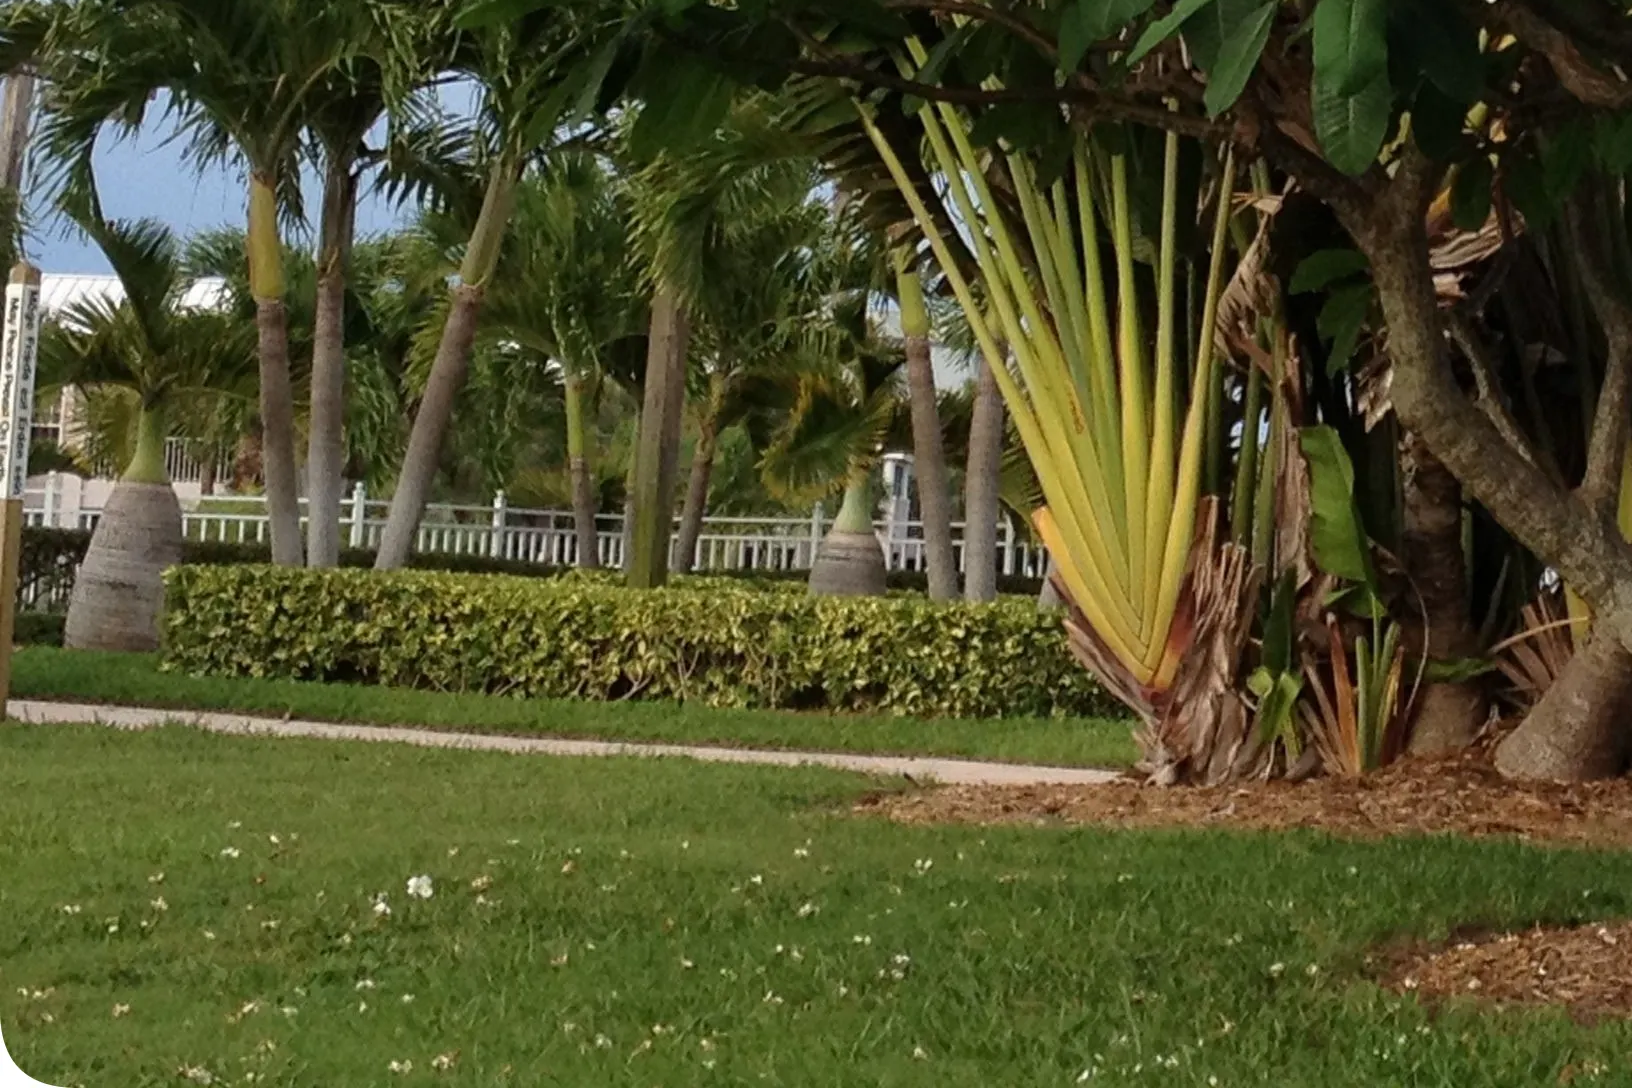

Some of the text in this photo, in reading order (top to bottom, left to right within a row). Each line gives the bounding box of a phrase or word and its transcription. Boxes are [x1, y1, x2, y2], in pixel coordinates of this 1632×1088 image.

[8, 297, 19, 325] May
[5, 330, 17, 371] Peace
[0, 420, 10, 442] On
